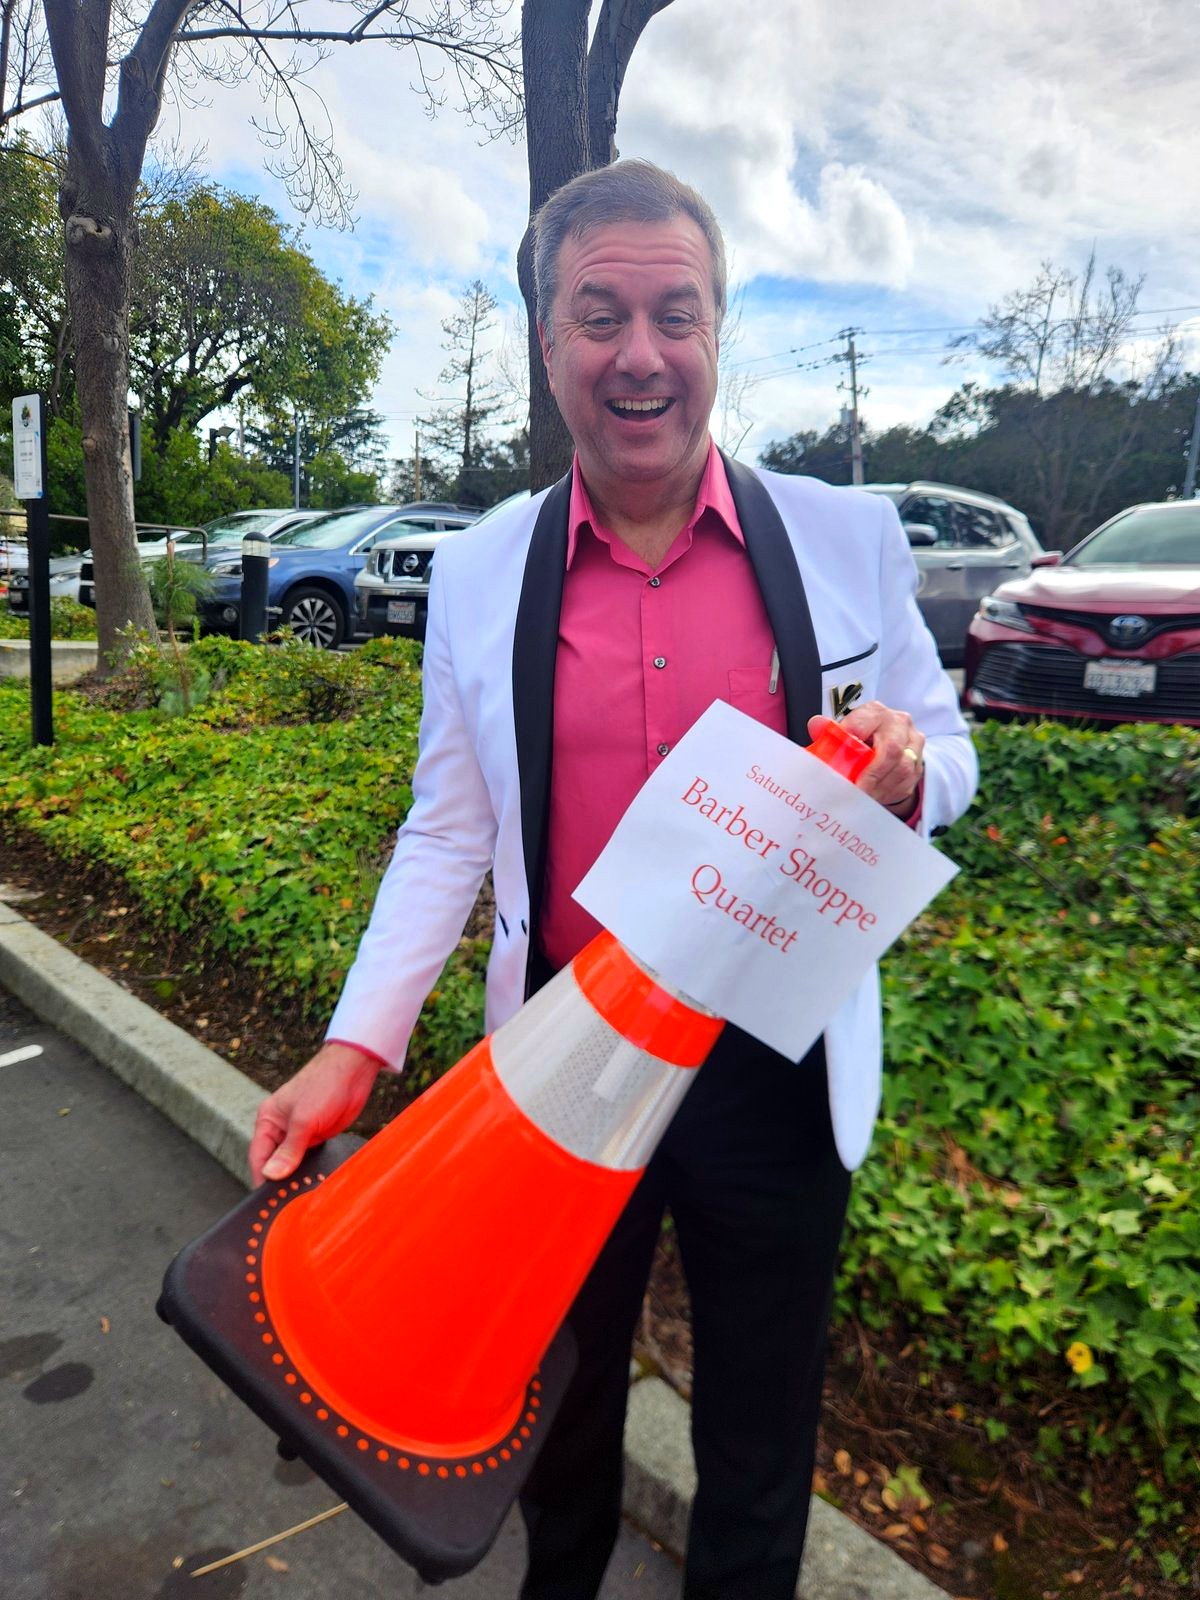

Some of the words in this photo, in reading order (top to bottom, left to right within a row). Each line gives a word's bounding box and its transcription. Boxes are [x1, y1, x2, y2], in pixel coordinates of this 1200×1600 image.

[680, 776, 781, 859] Barber
[779, 848, 878, 931] Shoppe
[746, 765, 817, 821] Saturday
[815, 813, 880, 867] 2/14/2026
[691, 863, 799, 953] Quartet
